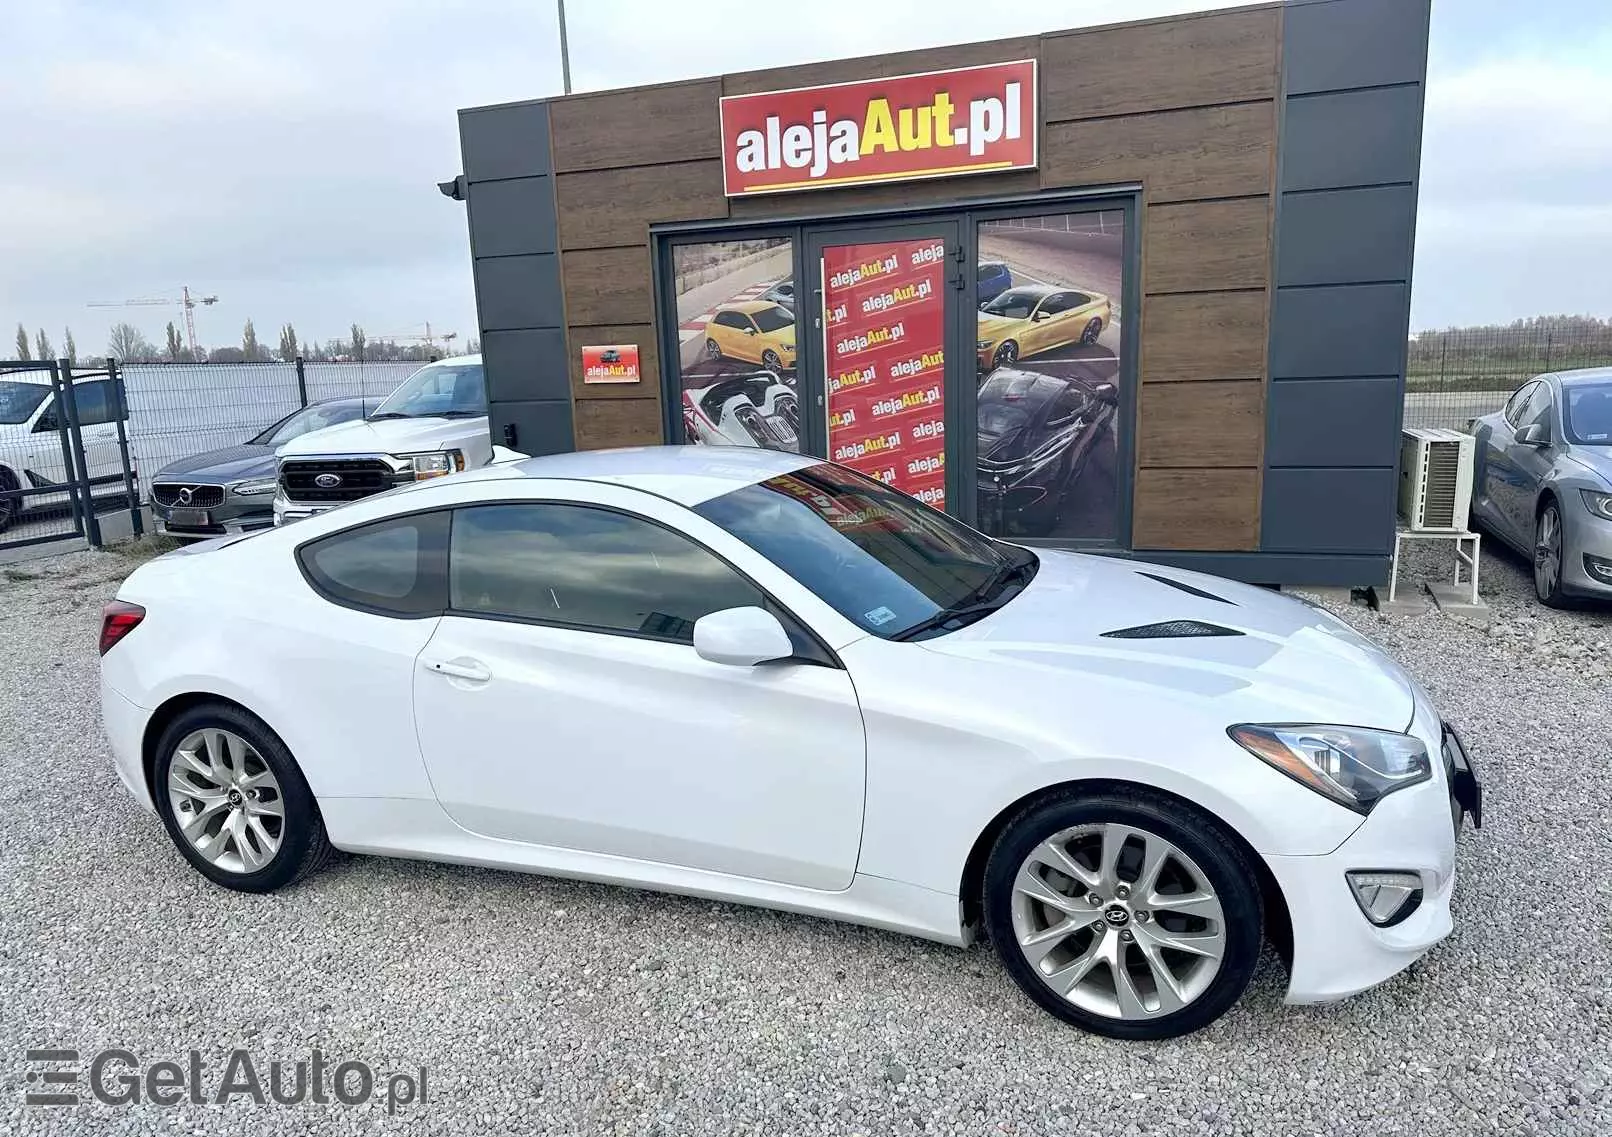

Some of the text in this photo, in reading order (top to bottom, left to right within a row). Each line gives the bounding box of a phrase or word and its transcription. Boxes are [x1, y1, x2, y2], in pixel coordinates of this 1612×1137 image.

[736, 83, 1020, 177] alejaAut.pl
[830, 254, 898, 288] alejaAut.pl
[862, 279, 931, 311] alejaAut.pl
[837, 322, 904, 354] alejaAut.pl
[587, 364, 636, 378] alejaAut.pl
[872, 386, 940, 416] alejaAut.pl
[835, 432, 900, 459] alejaAut.pl
